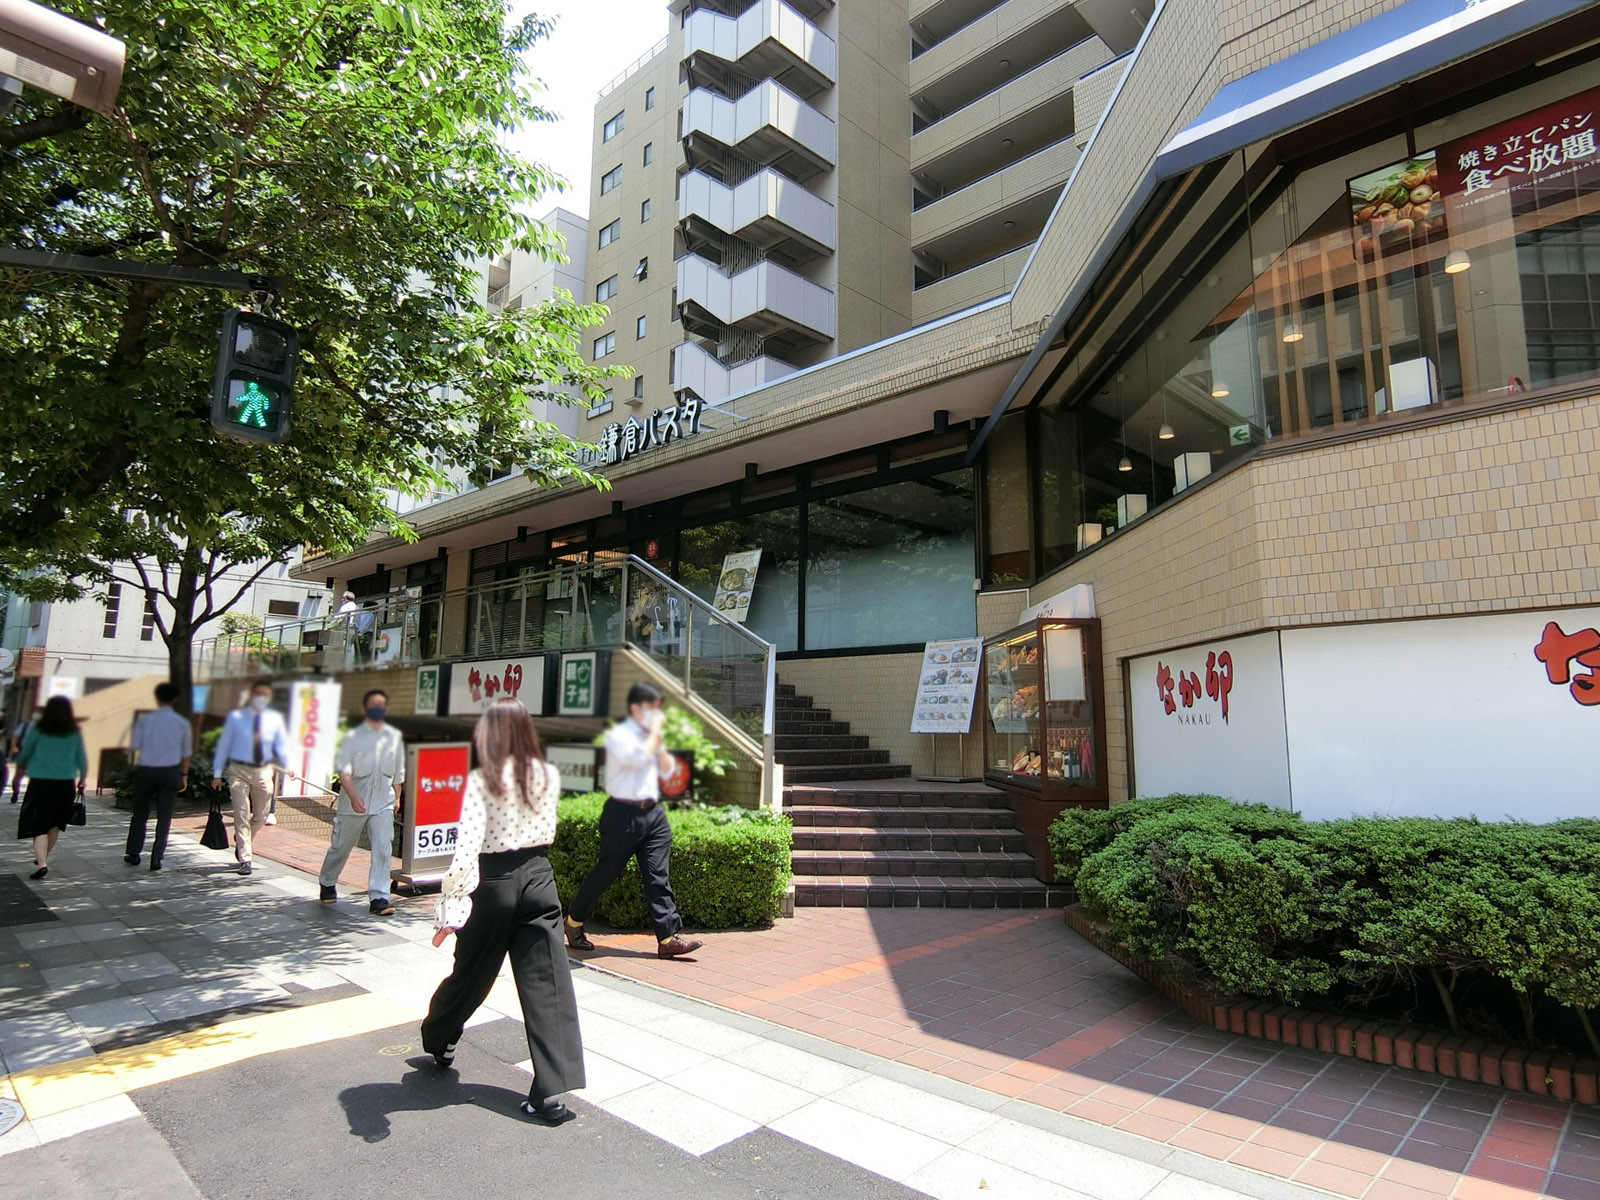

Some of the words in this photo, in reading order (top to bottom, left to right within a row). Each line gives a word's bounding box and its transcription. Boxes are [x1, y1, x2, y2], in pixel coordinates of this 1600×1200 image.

[1458, 111, 1593, 172] 焼き立てパン
[1460, 128, 1598, 197] 食べ放題
[600, 397, 702, 465] 鎌倉パスタ
[468, 663, 523, 703] なか卯
[1156, 650, 1233, 726] なか卯
[1178, 713, 1211, 725] NAKAU
[417, 826, 458, 849] 56席
